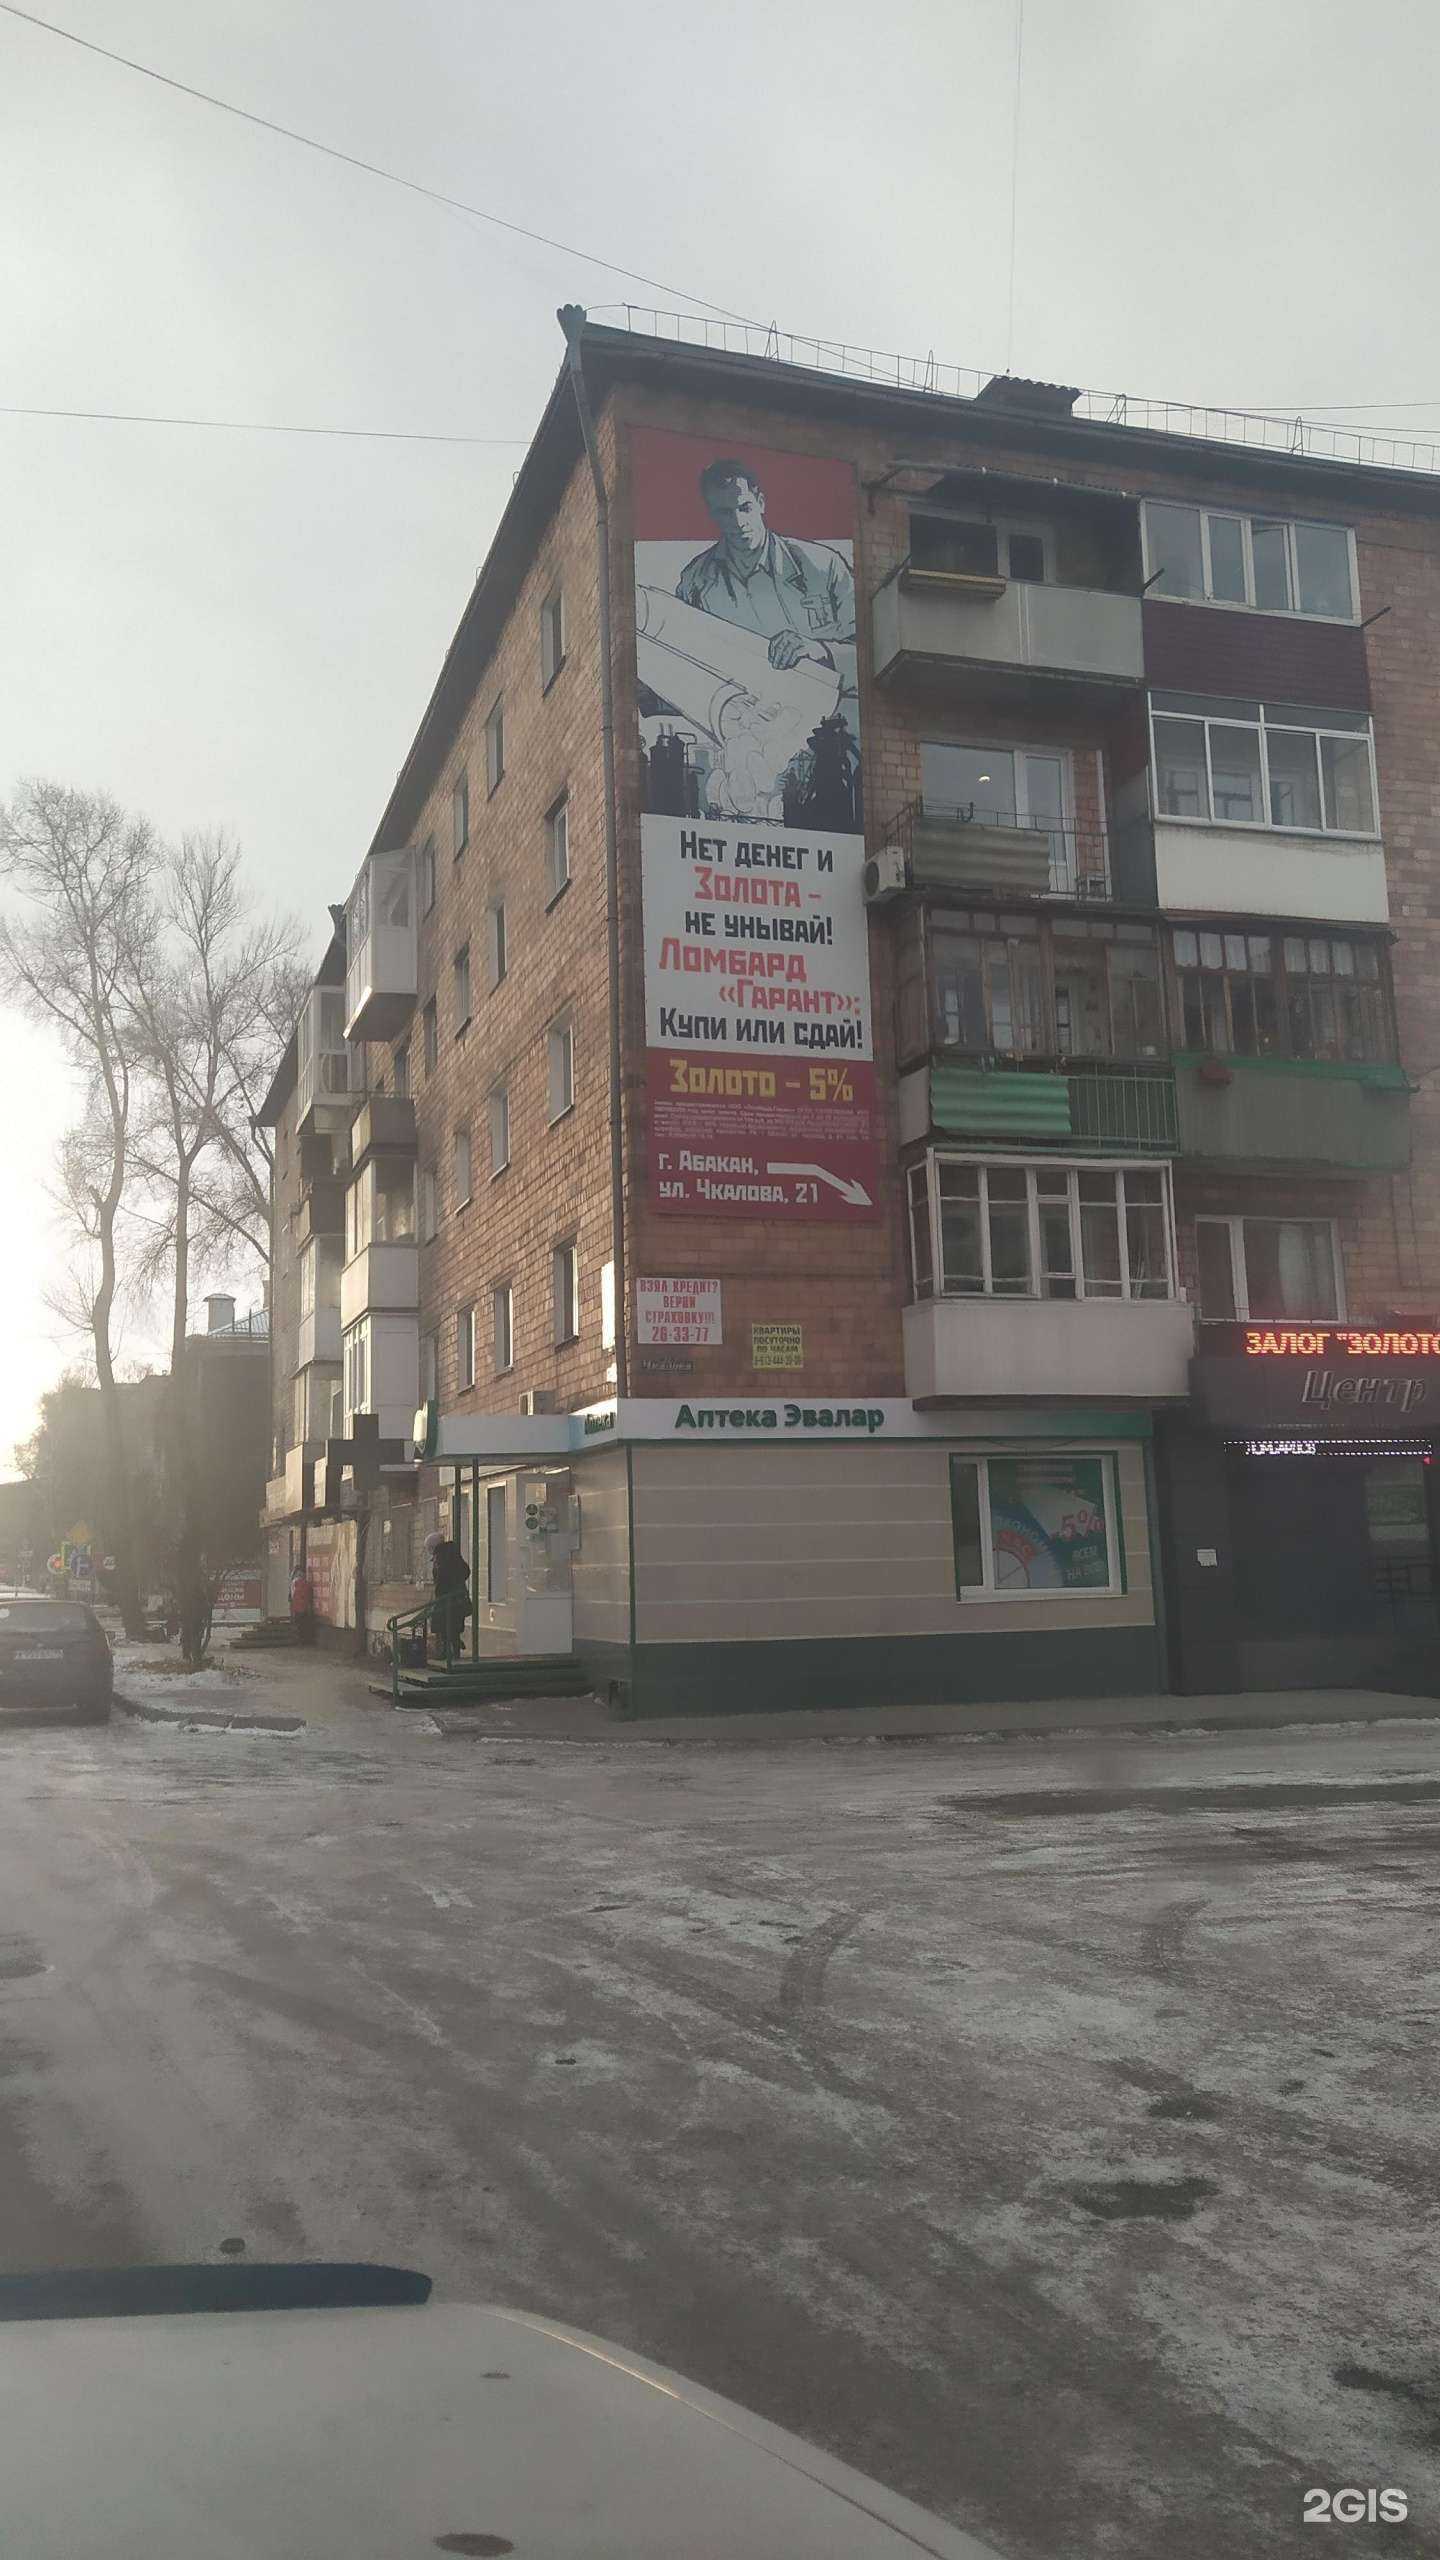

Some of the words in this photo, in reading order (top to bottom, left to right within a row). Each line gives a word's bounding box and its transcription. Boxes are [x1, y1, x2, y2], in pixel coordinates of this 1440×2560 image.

[818, 850, 833, 872] И
[685, 911, 716, 935] НЕ
[736, 1019, 785, 1044] ИЛИ
[809, 1067, 853, 1101] 5%
[796, 1183, 818, 1204] 21
[1246, 1332, 1331, 1354] ЗАЛОГ
[1302, 1369, 1425, 1413] Центр
[675, 1404, 778, 1428] Аптека
[784, 1403, 885, 1433] Эвалар
